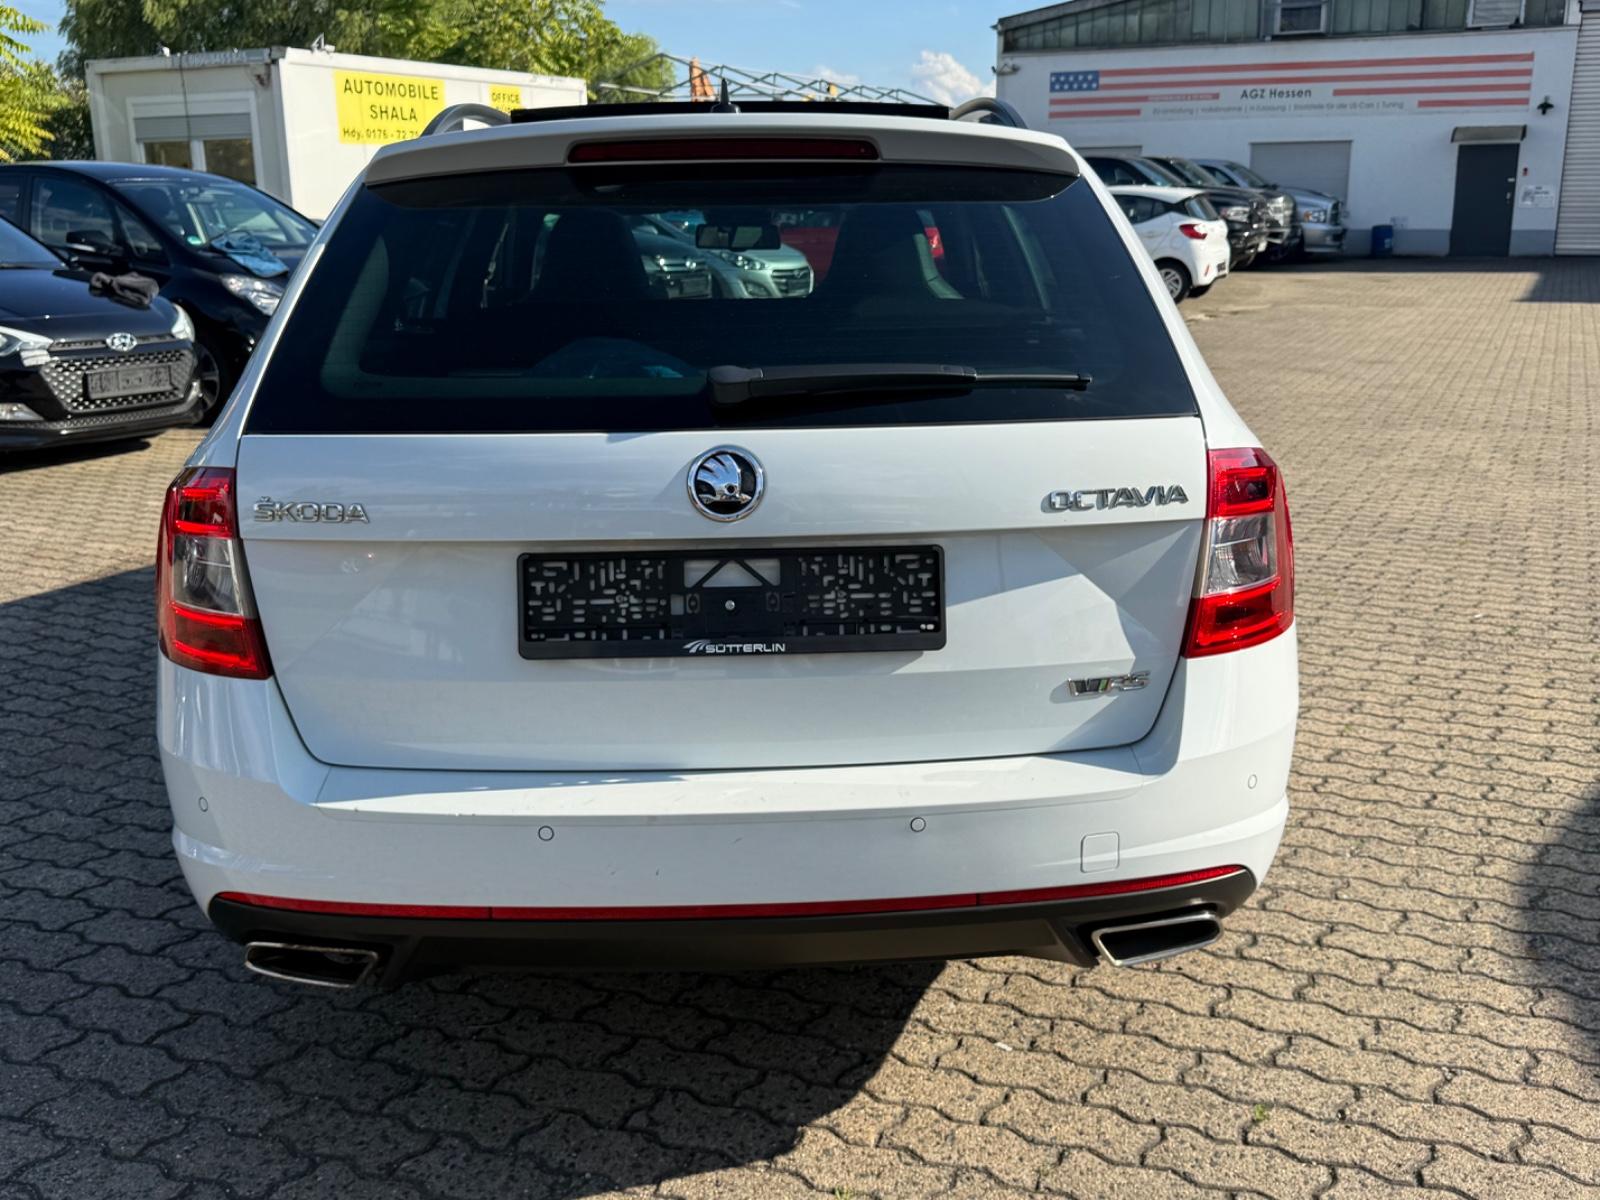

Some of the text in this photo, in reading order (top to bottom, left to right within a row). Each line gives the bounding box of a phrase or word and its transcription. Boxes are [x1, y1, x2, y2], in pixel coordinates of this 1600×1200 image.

[343, 78, 439, 100] AUTOMOBILE
[491, 92, 520, 103] OFFICE
[1240, 87, 1312, 99] AGZ Hessen
[370, 104, 418, 122] SHALA
[1045, 484, 1189, 513] OCTAVIA
[253, 496, 370, 524] ŠKODA
